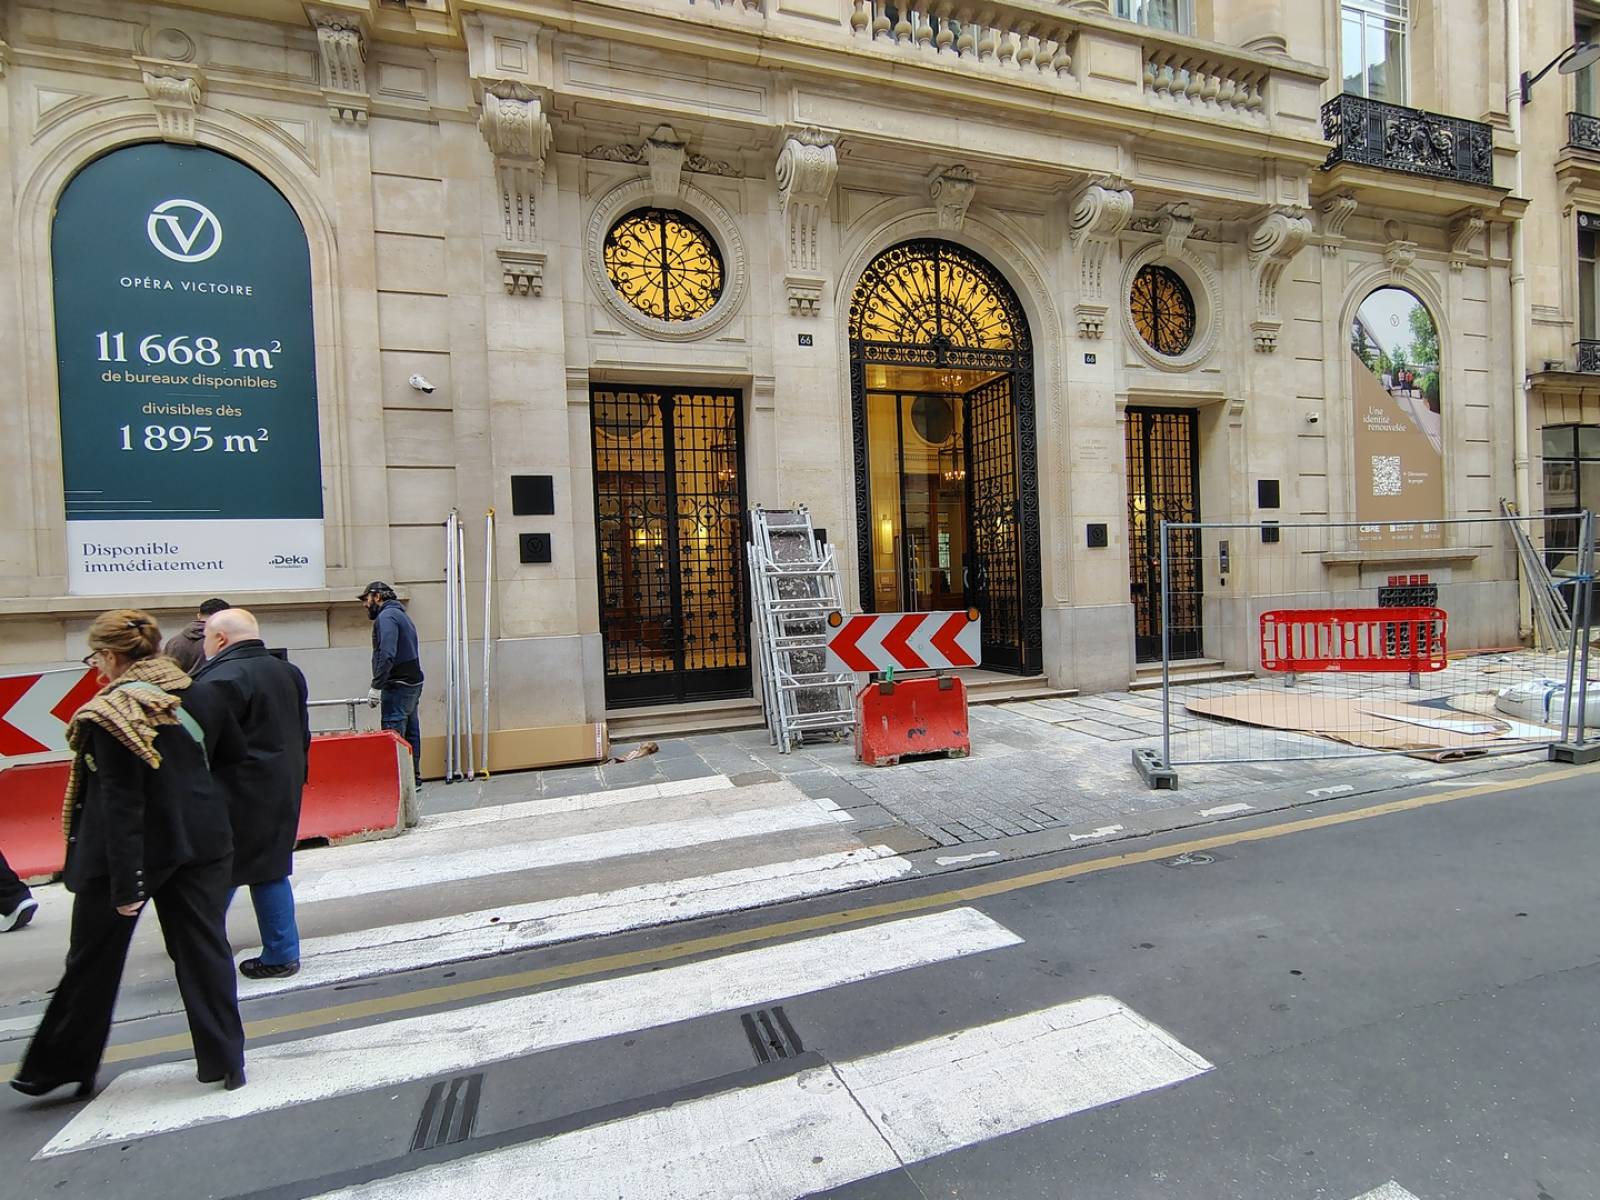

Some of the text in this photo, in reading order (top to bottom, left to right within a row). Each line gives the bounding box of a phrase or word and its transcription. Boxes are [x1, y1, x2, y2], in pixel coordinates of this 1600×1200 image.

[120, 276, 254, 296] OPÉRA VICTOIRE
[799, 335, 811, 345] 66
[95, 331, 128, 362] 11
[139, 334, 221, 366] 668
[1086, 354, 1096, 363] 66
[101, 370, 278, 389] de bureaux disponibles
[142, 402, 242, 417] divisibles dès
[119, 424, 133, 450] 1
[143, 424, 214, 452] 895
[82, 542, 179, 559] Disponible
[84, 557, 224, 573] immédiatement
[274, 554, 309, 565] Deka
